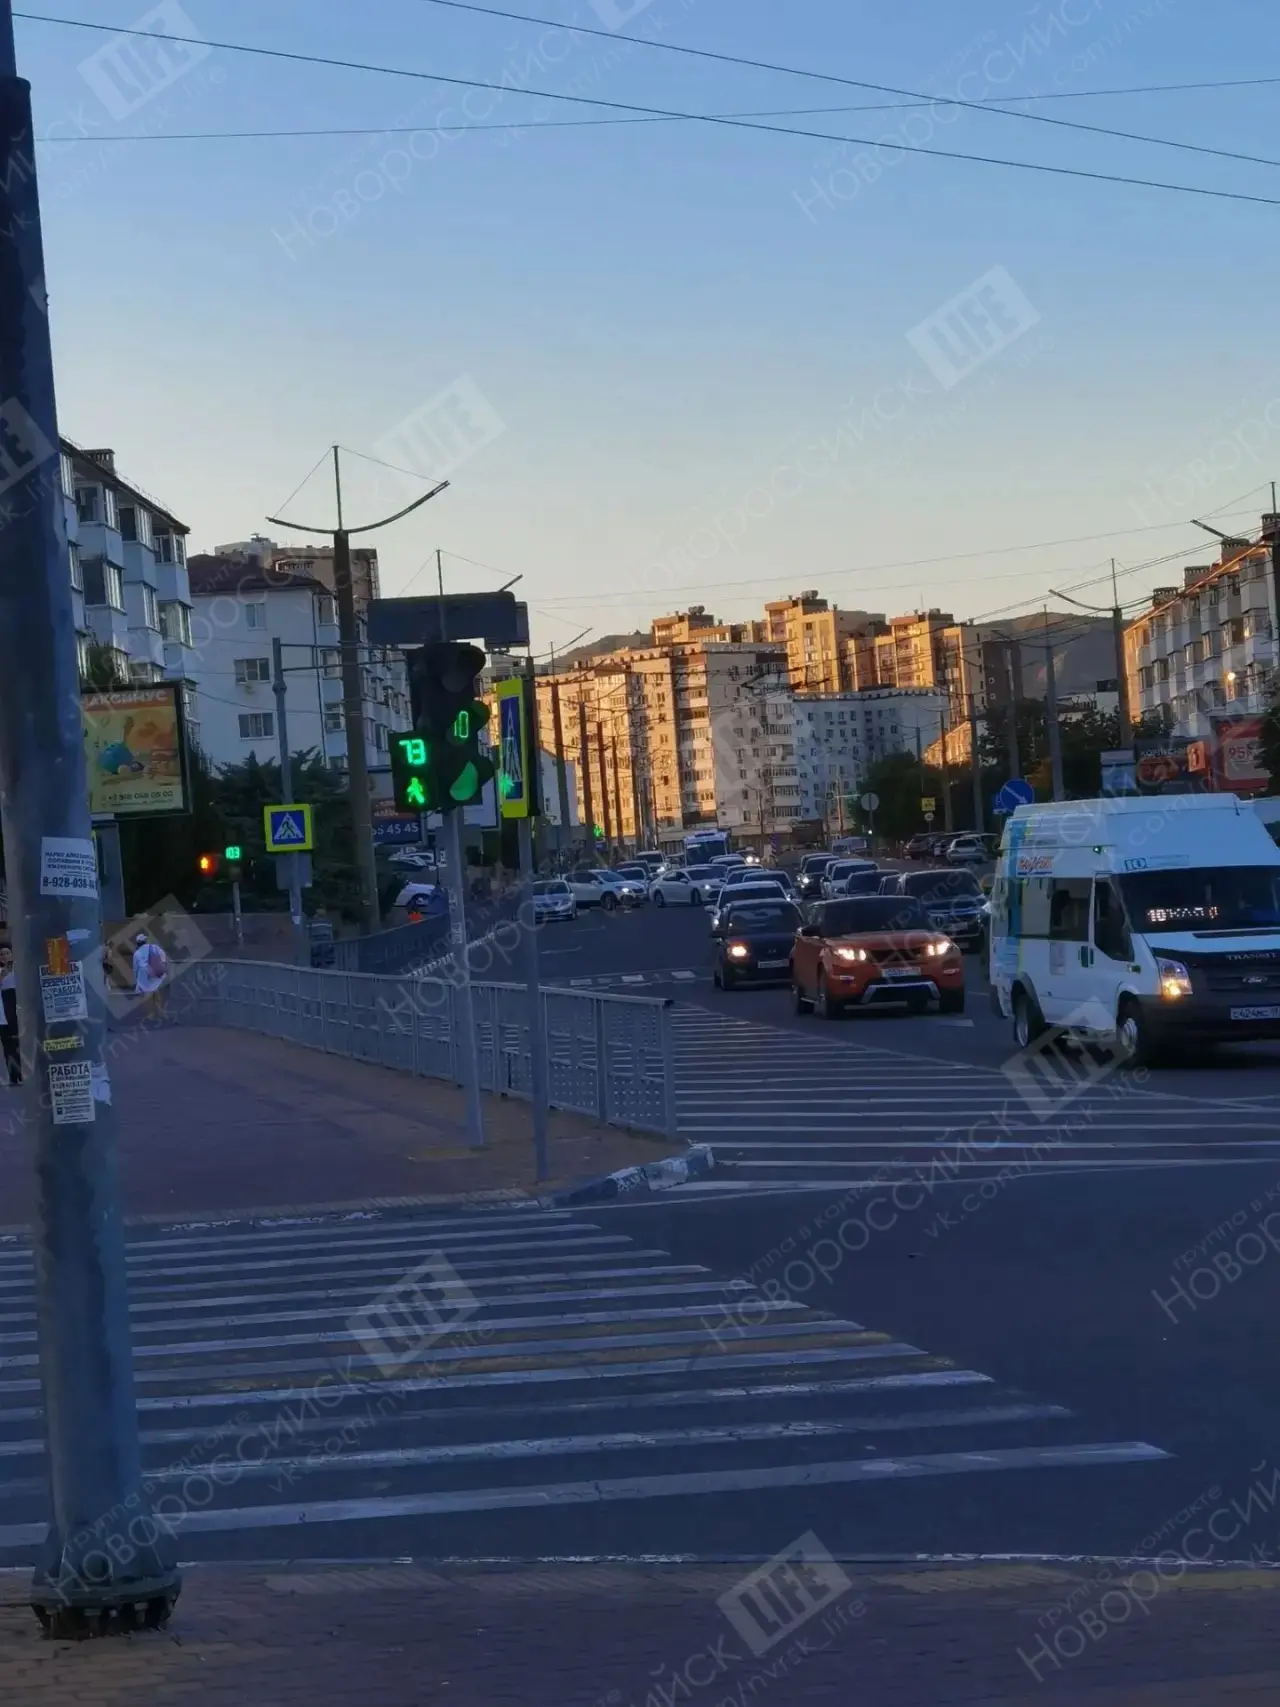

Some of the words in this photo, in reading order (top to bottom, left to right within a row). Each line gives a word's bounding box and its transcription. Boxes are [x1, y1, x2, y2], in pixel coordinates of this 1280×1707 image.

[454, 710, 469, 738] 10
[399, 738, 426, 765] 73
[386, 823, 402, 835] 45
[403, 821, 420, 833] 45
[50, 1063, 91, 1077] РАБОТА
